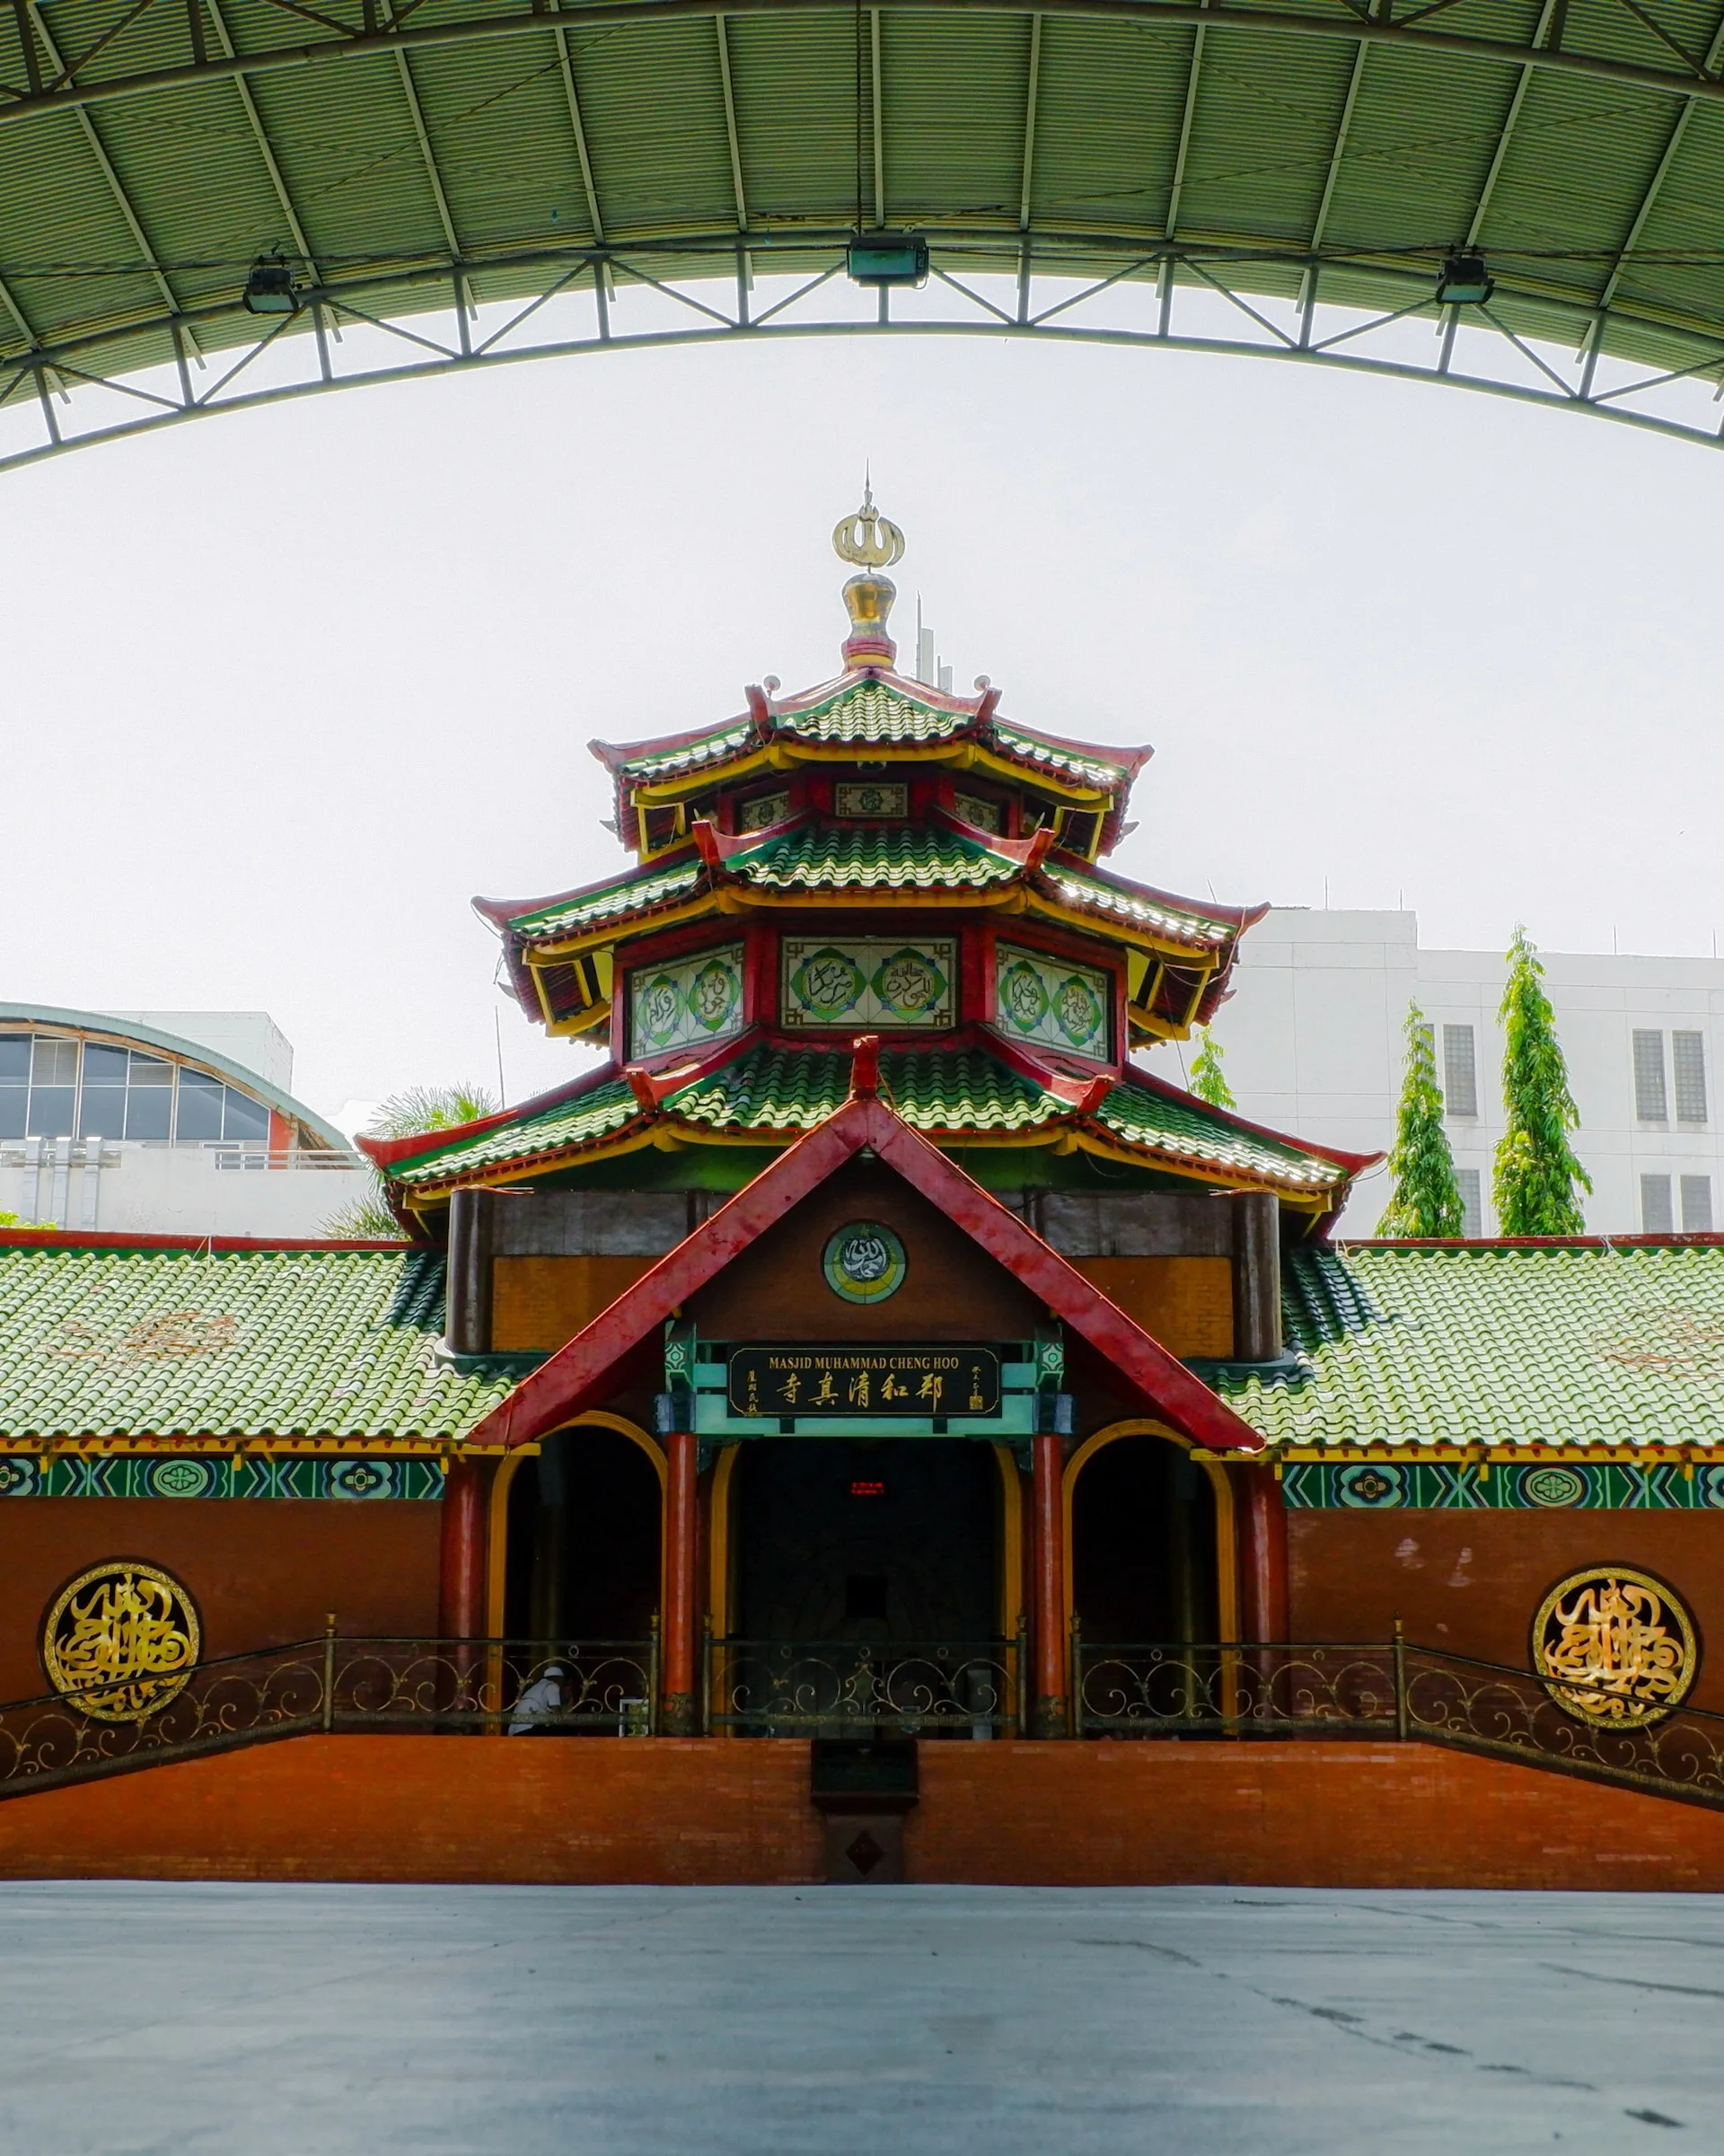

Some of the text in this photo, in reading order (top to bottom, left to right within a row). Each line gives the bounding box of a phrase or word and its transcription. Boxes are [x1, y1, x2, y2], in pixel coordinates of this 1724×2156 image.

[769, 1357, 959, 1369] MASJID MUHAMMAD CHENG HOO
